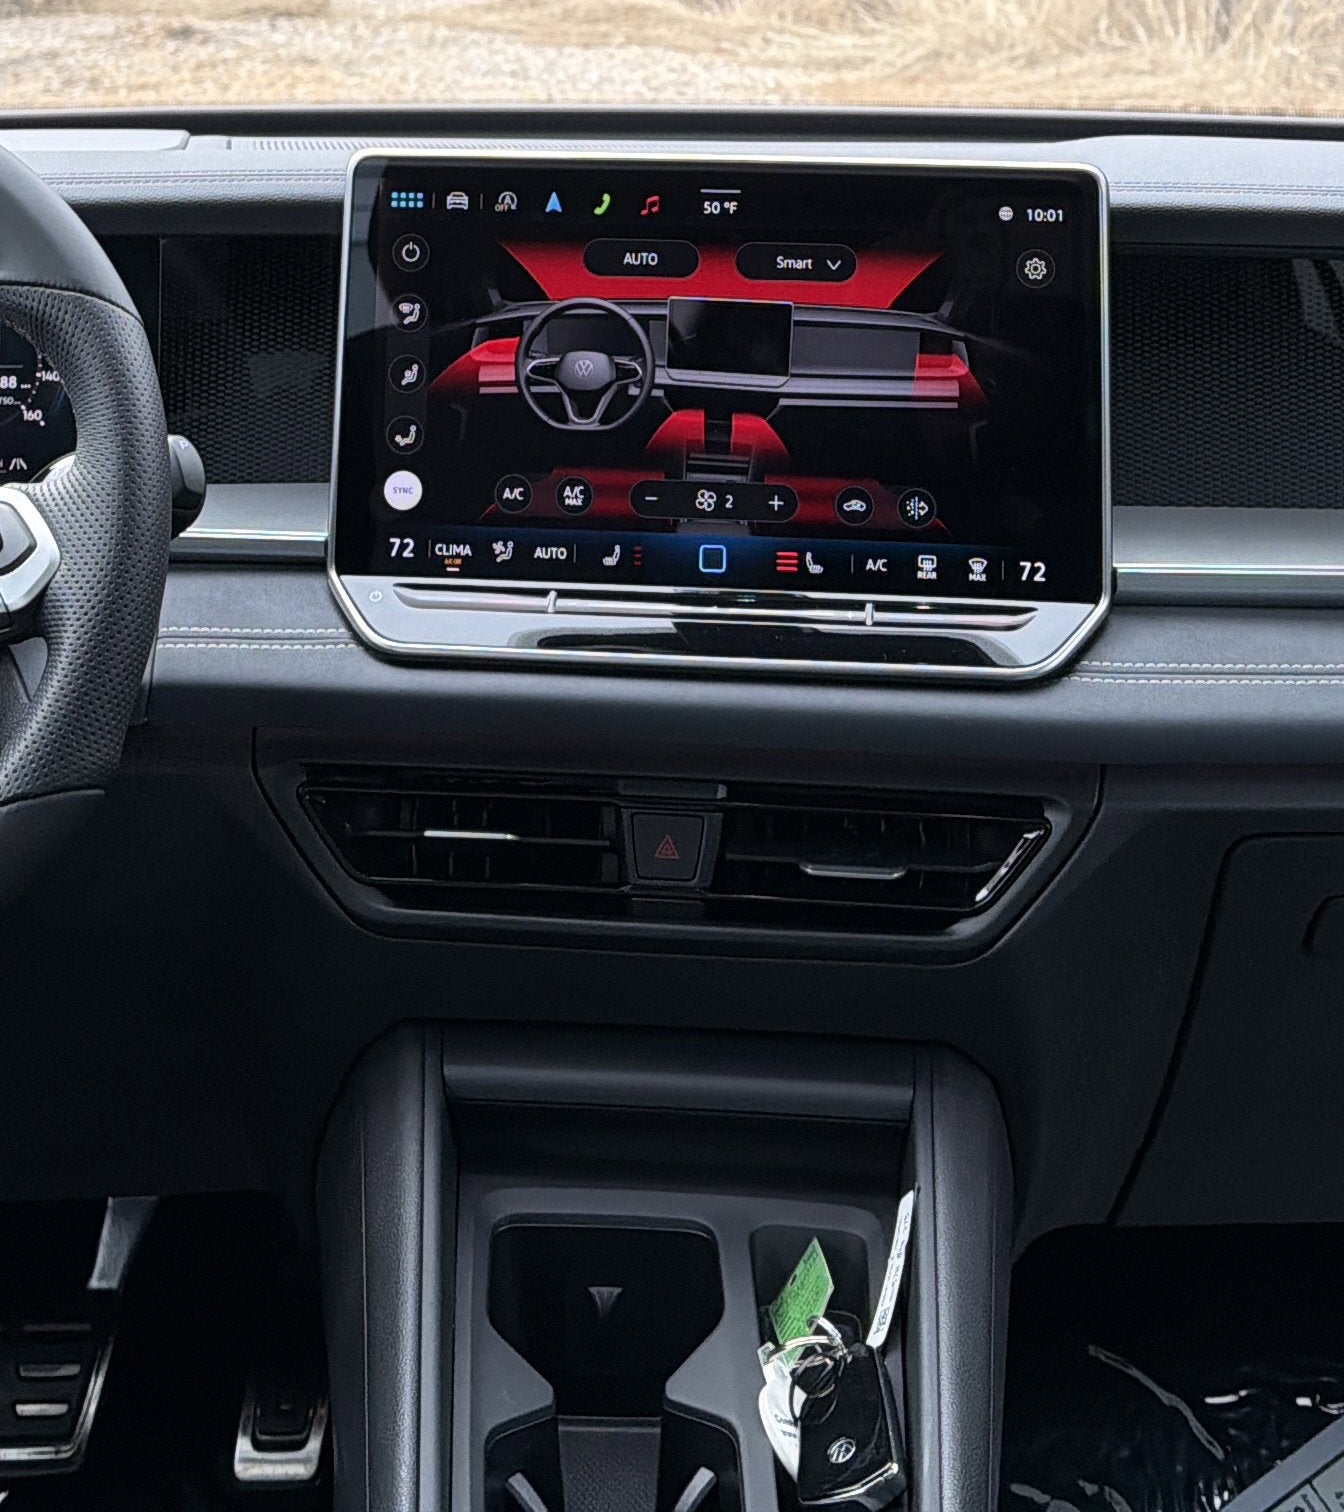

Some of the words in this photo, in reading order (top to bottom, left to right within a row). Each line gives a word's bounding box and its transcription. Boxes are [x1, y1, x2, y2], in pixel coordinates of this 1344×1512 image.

[494, 204, 508, 213] OFF
[703, 201, 721, 215] 50
[724, 201, 738, 215] °F
[1026, 208, 1064, 223] 10:01
[623, 252, 658, 265] AUTO
[776, 255, 813, 269] Smart
[41, 371, 60, 382] 140
[23, 410, 42, 421] 160
[392, 486, 414, 495] SYNC
[502, 487, 524, 501] A/C
[563, 485, 585, 499] A/C
[564, 498, 583, 507] MAX
[725, 494, 733, 509] 2
[389, 538, 415, 558] 72
[435, 544, 472, 557] CLIMA
[534, 546, 567, 560] AUTO
[865, 558, 888, 572] A/C
[1019, 561, 1046, 582] 72
[917, 571, 937, 580] REAR
[968, 573, 987, 581] MAX
